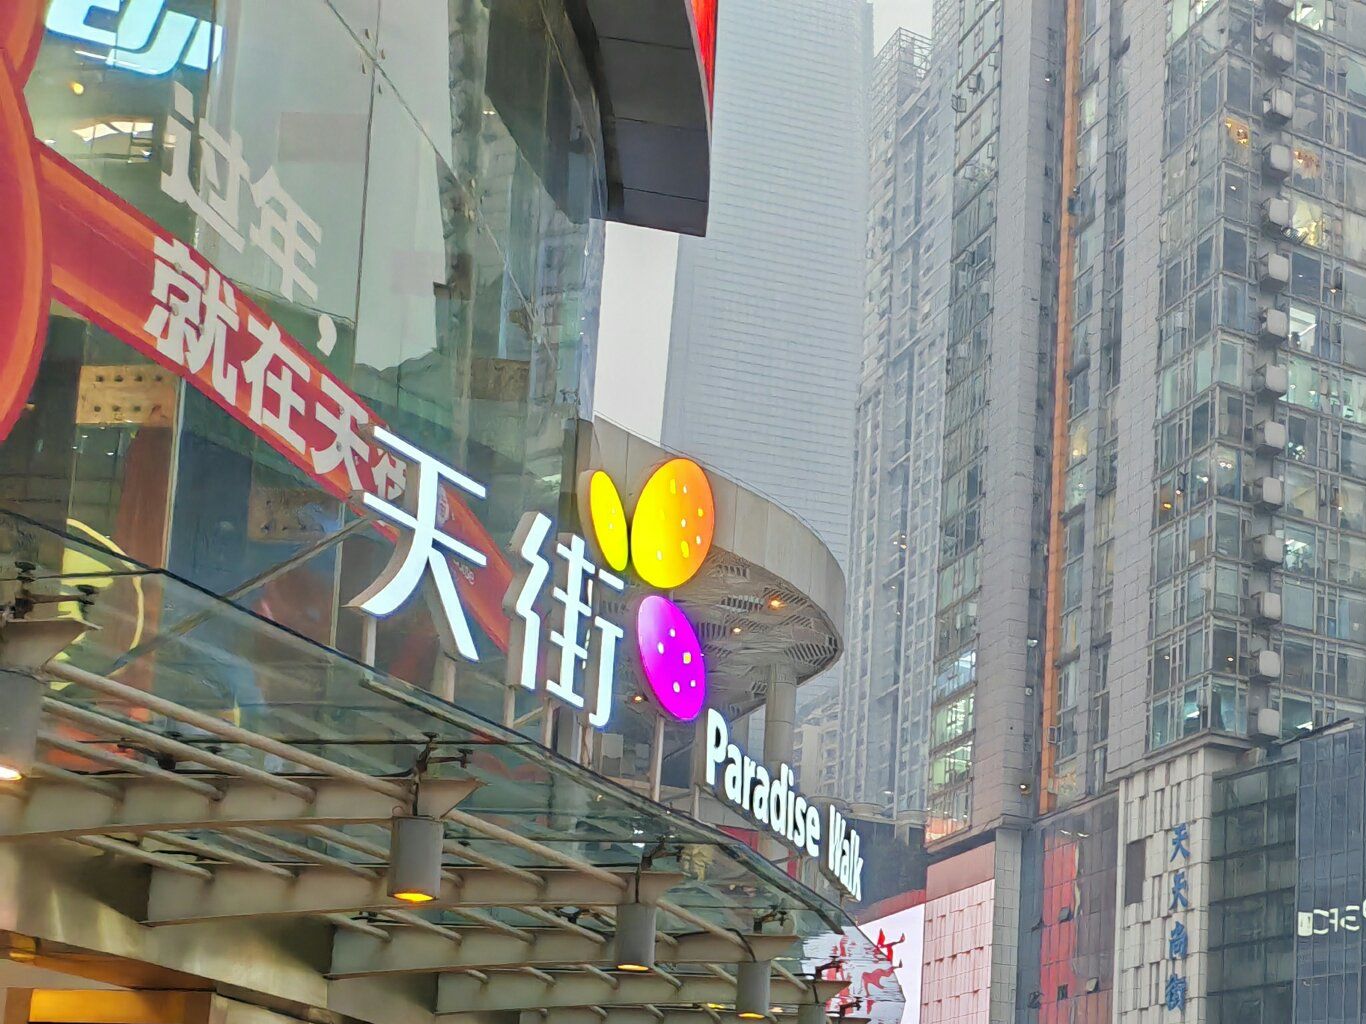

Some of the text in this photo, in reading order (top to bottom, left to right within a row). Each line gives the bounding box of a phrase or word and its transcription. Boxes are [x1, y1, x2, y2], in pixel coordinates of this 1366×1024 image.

[360, 425, 625, 727] 天街
[706, 708, 864, 901] Paradise Walk
